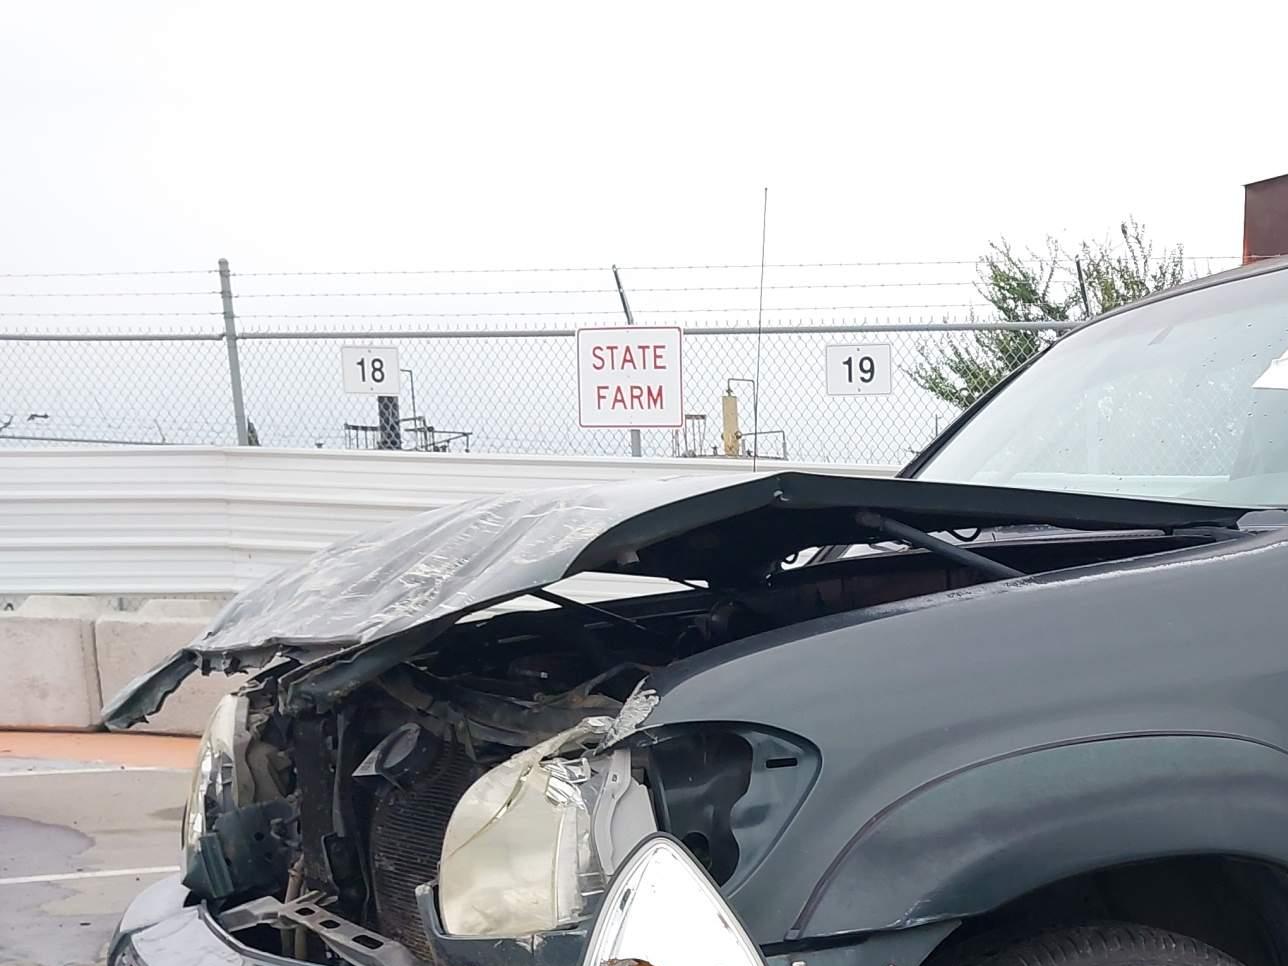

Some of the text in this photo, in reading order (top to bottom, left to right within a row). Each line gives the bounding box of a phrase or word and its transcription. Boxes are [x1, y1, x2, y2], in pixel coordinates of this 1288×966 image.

[356, 357, 386, 384] 18
[591, 344, 667, 371] STATE
[842, 355, 876, 384] 19
[595, 384, 664, 410] FARM
